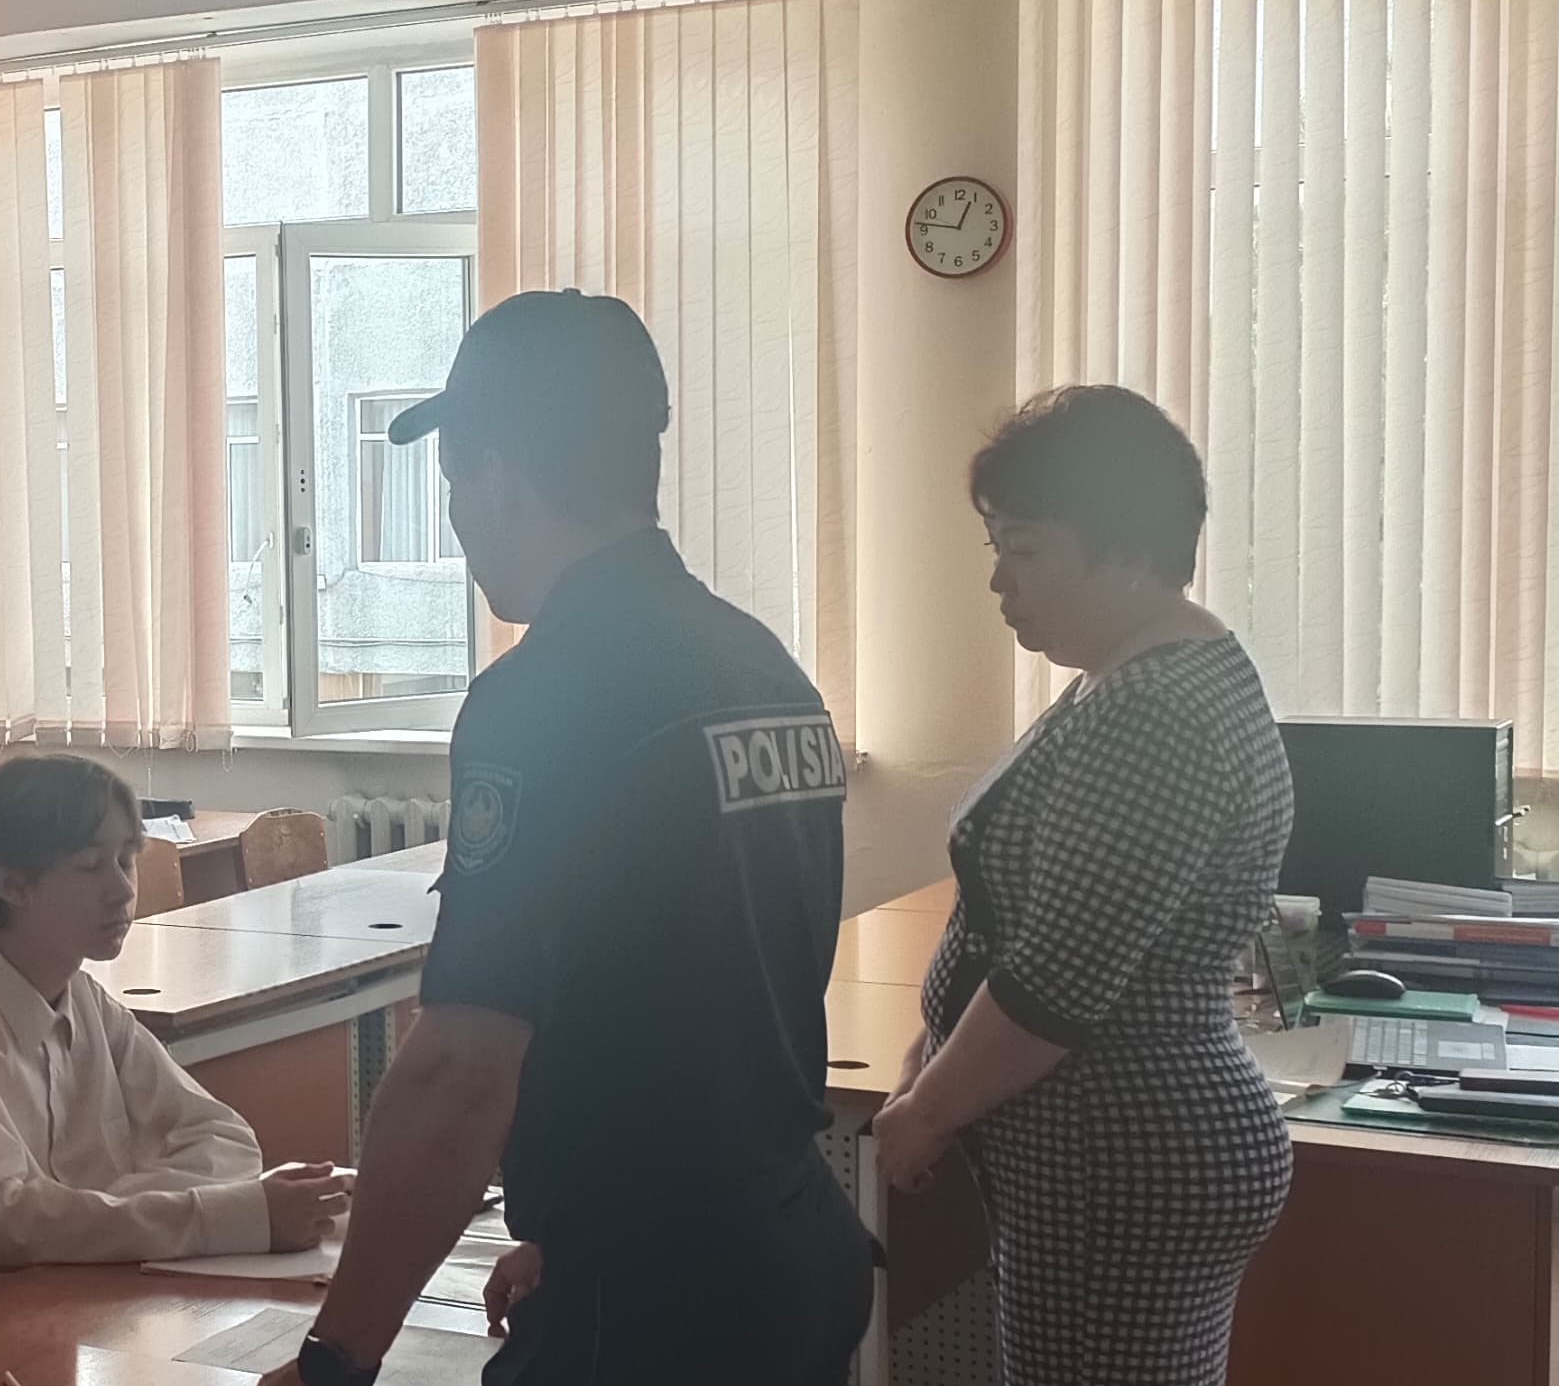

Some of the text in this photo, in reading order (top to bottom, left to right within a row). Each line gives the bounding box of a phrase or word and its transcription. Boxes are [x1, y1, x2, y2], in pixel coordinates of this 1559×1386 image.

[938, 195, 945, 207] 11
[954, 189, 966, 201] 12
[925, 208, 937, 220] 10
[984, 203, 993, 215] 2
[989, 220, 999, 231] 3
[925, 241, 934, 253] 8
[984, 237, 993, 247] 4
[937, 252, 946, 264] 7
[954, 256, 963, 267] 6
[971, 250, 980, 261] 5
